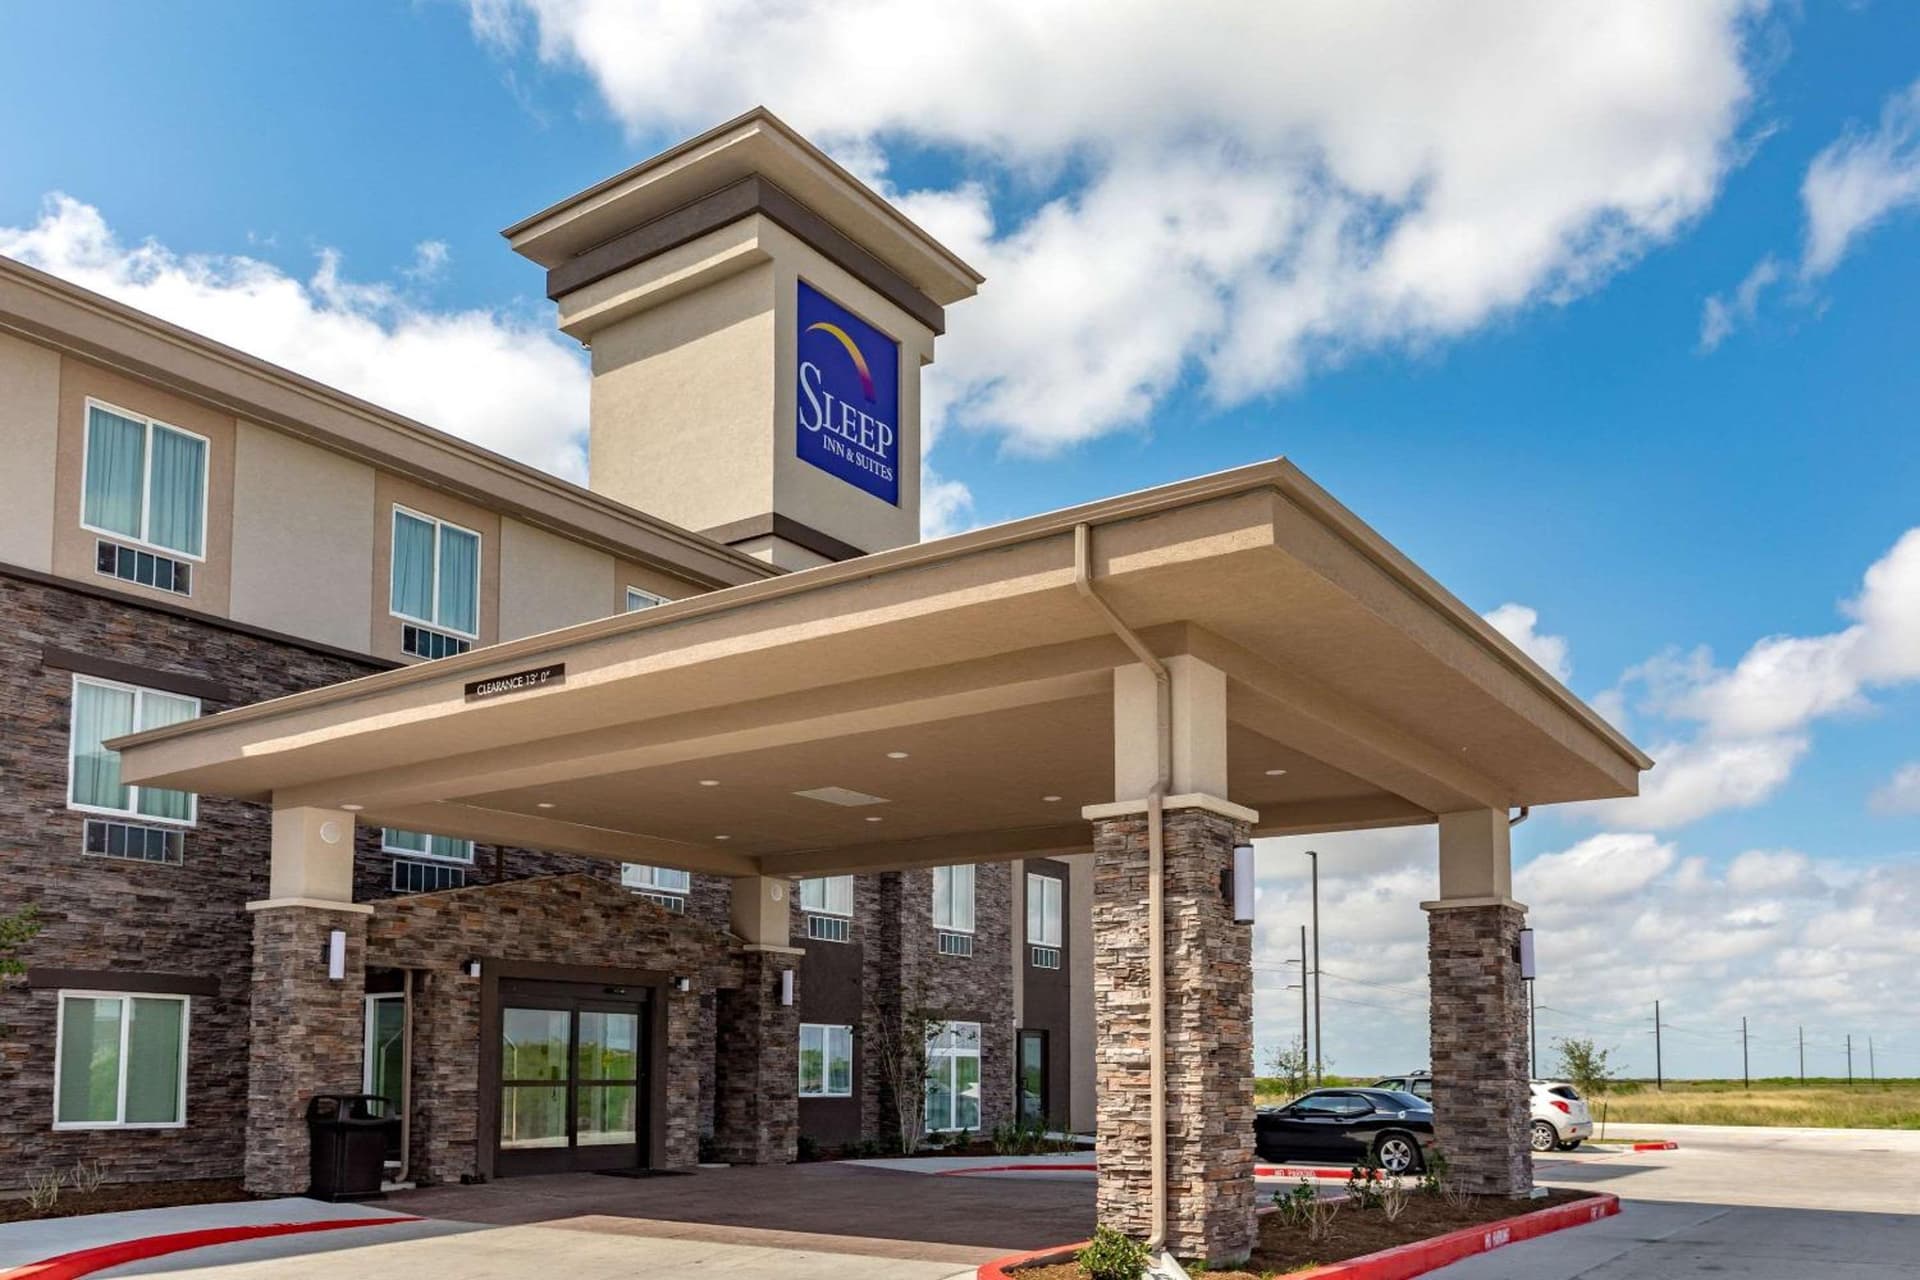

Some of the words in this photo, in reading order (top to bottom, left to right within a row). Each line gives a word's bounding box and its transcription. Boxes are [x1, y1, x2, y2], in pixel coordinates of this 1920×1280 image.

[800, 361, 893, 458] SLEEP
[823, 434, 844, 458] INN
[846, 448, 854, 463] &
[855, 452, 893, 481] SUITES
[477, 676, 523, 695] CLEARANCE
